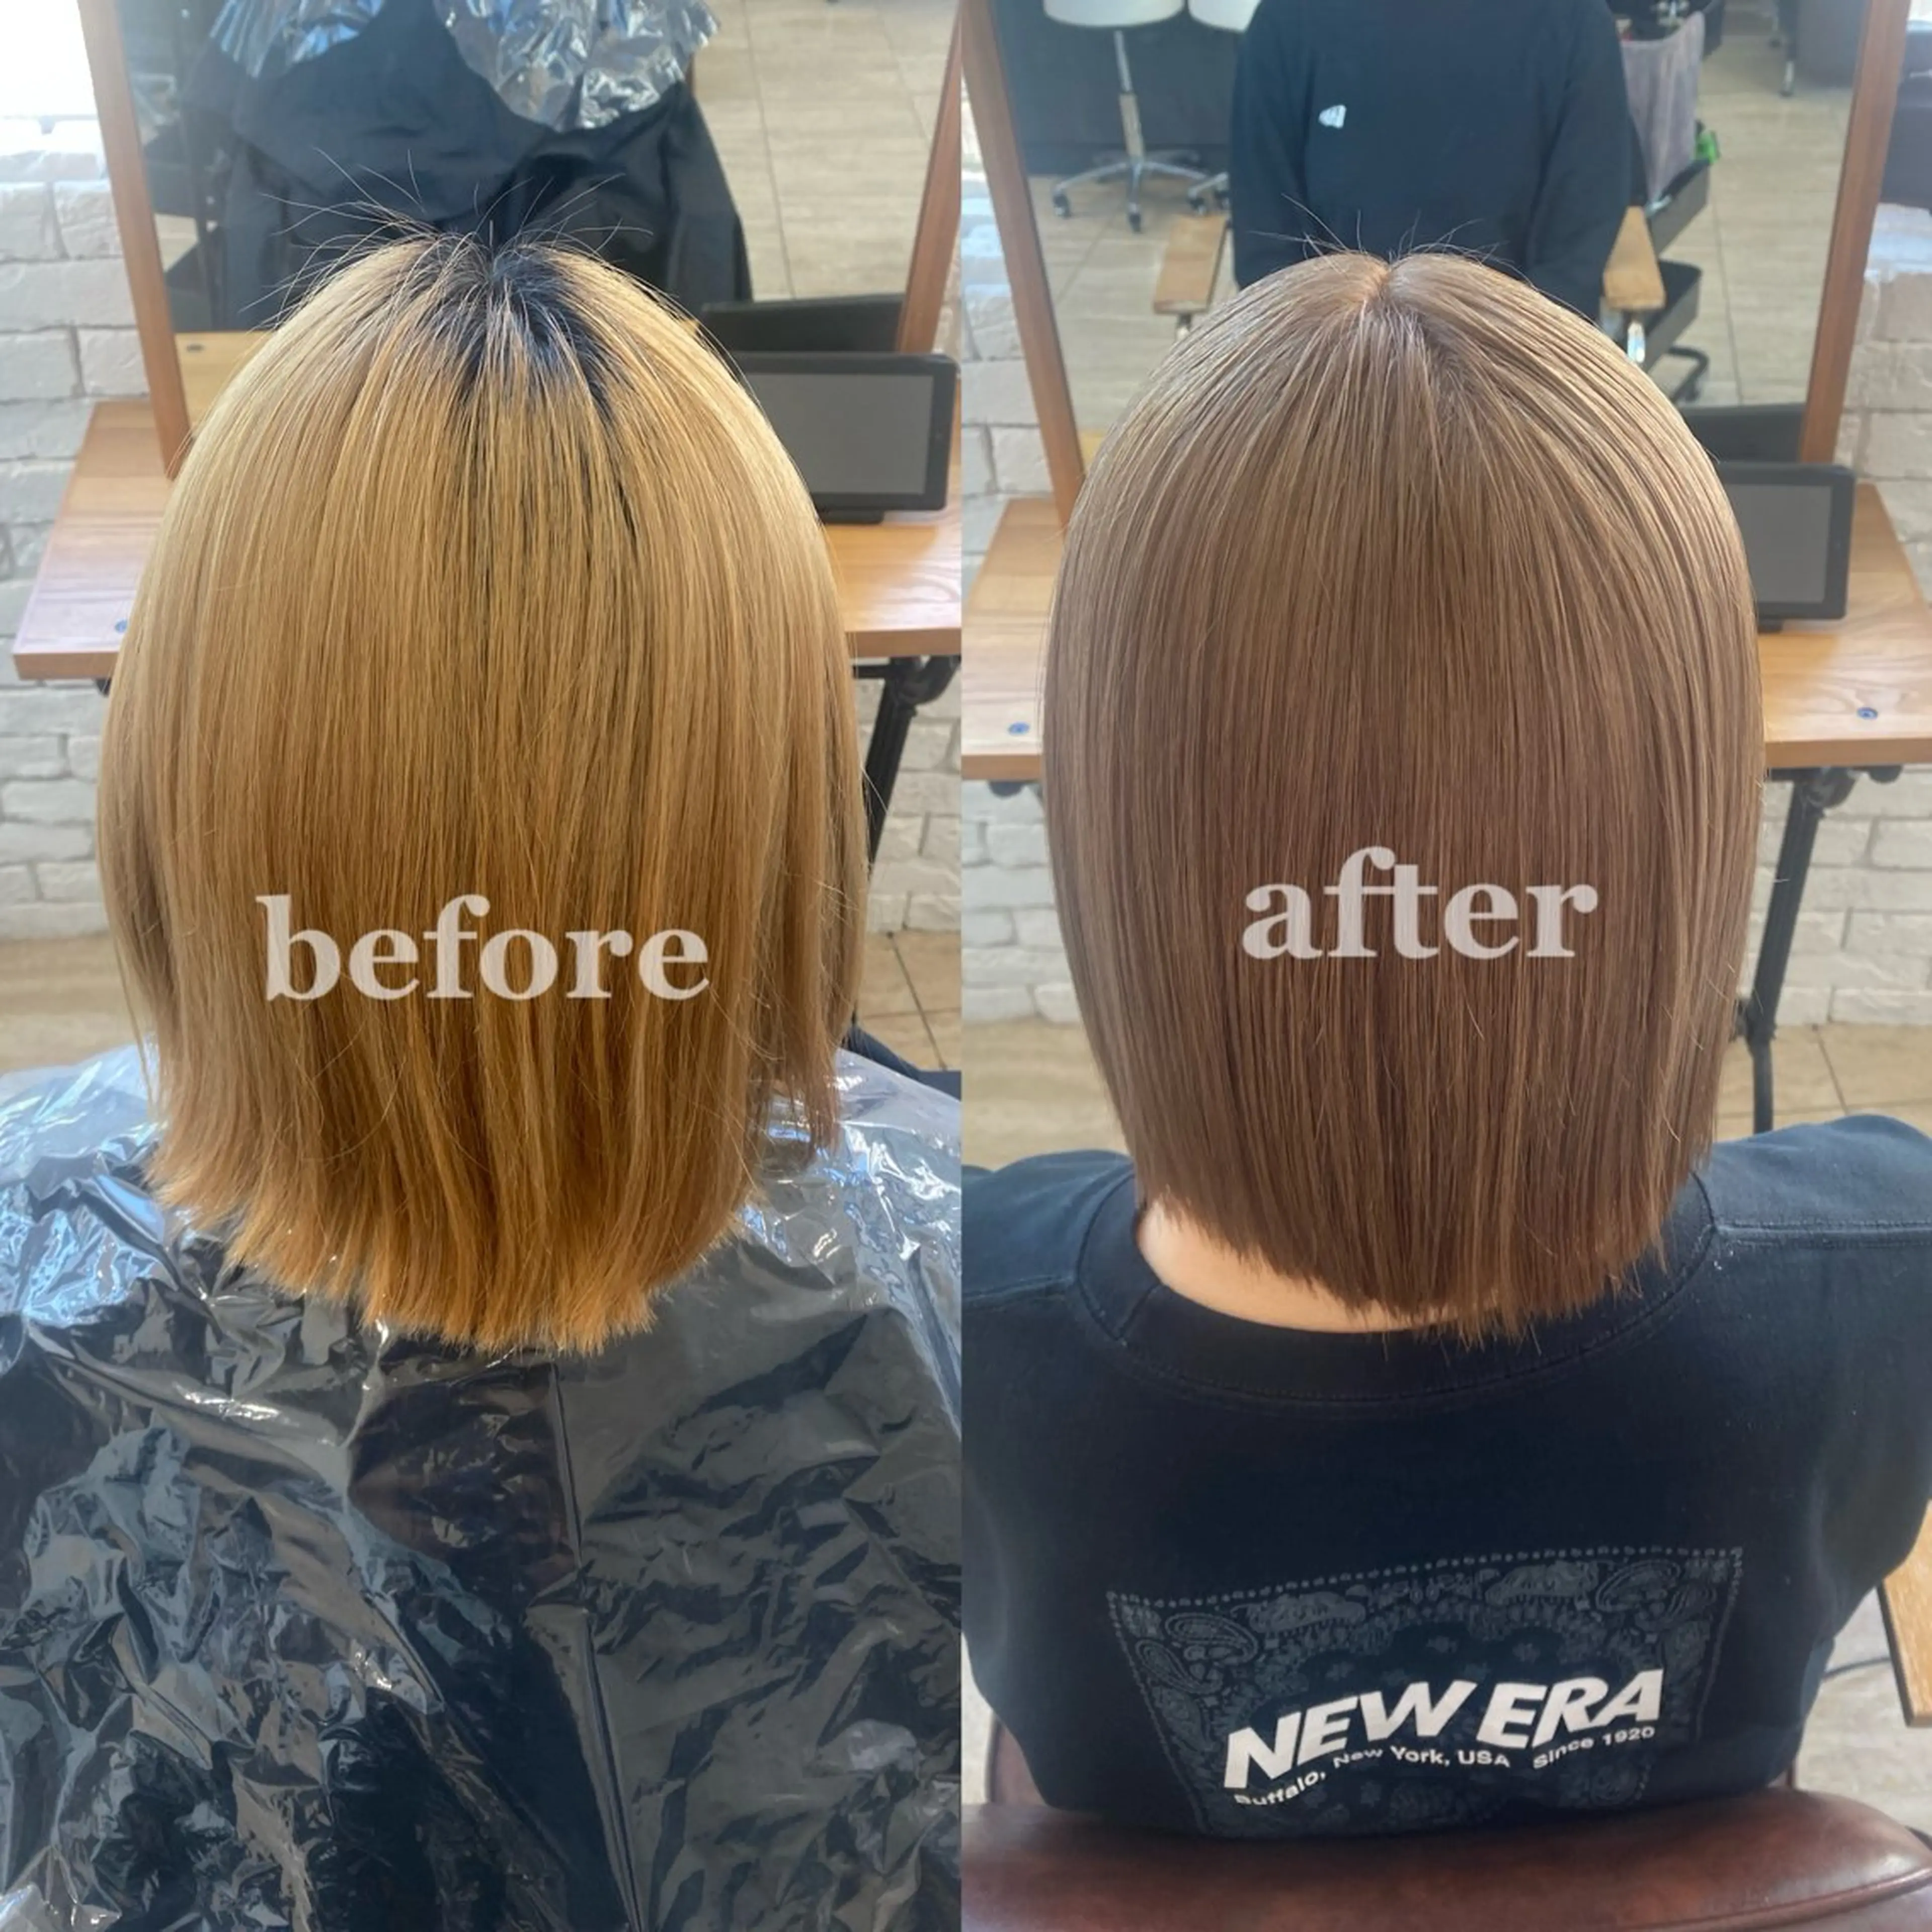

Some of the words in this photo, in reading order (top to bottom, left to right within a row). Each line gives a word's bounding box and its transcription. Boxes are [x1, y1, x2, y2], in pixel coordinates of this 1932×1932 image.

[1223, 1679, 1478, 1790] NEW
[1475, 1668, 1664, 1749] ERA
[1332, 1748, 1384, 1769] New
[1389, 1744, 1452, 1767] York,
[1456, 1748, 1511, 1768] USA
[1532, 1736, 1595, 1770] Since
[1601, 1725, 1657, 1746] 1920
